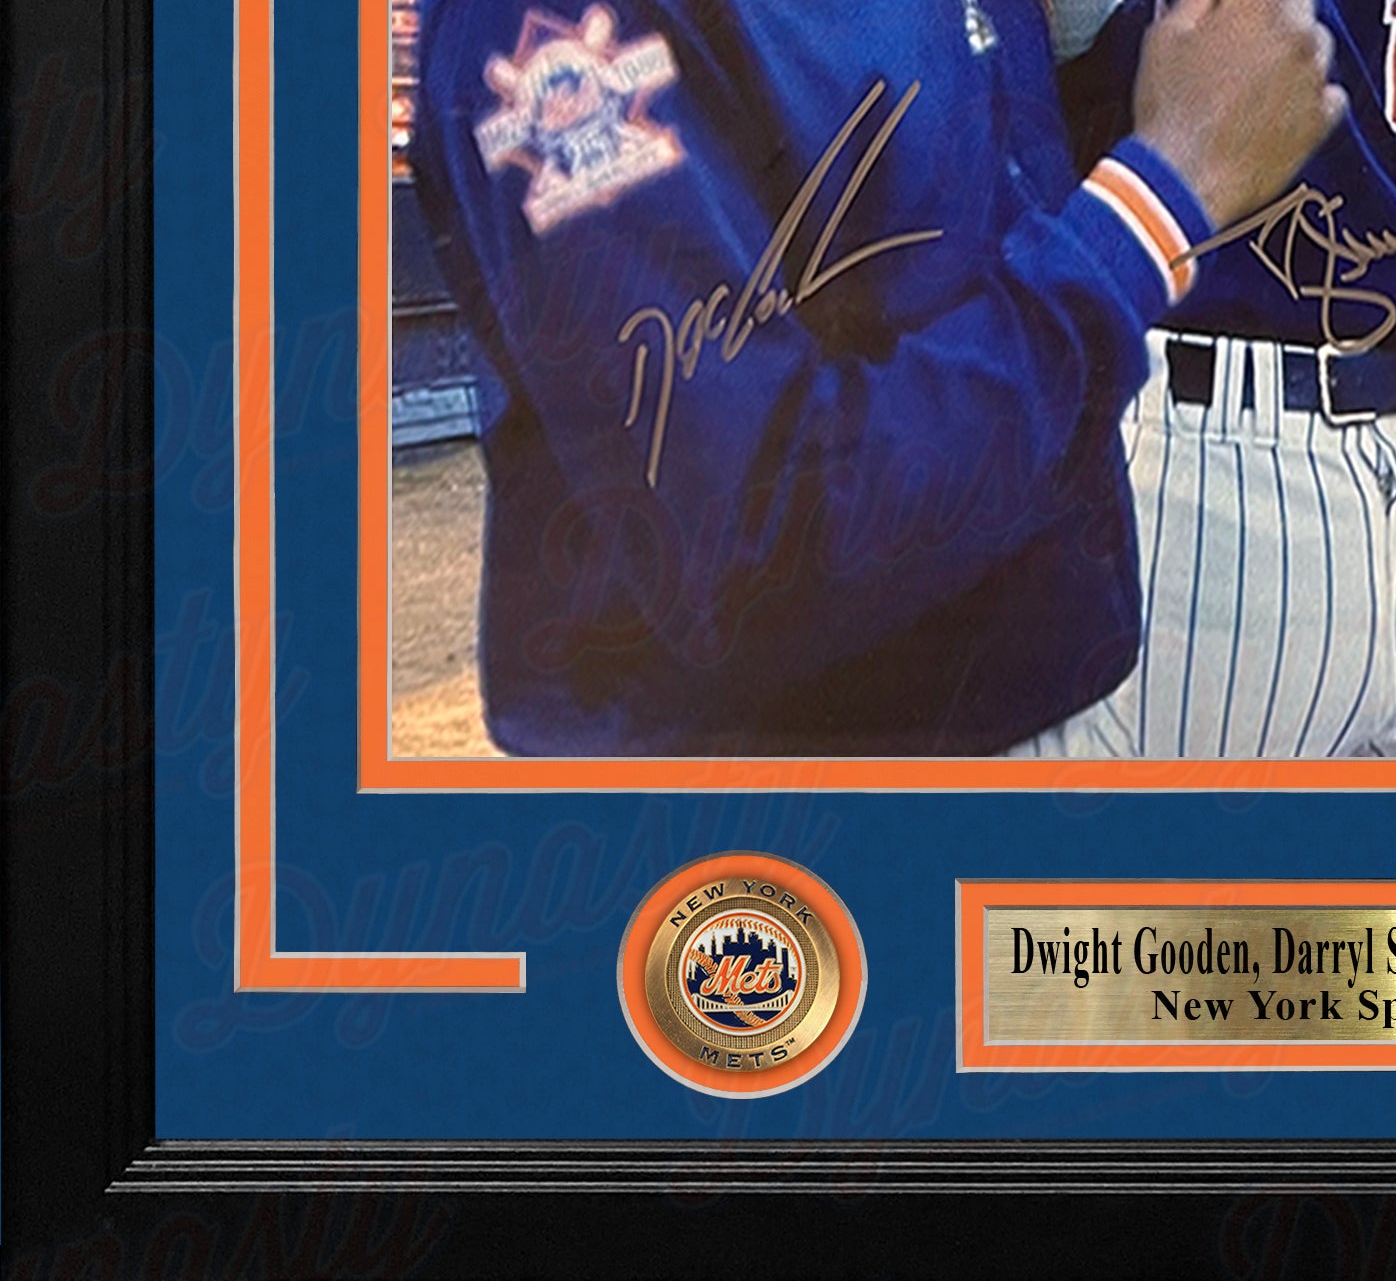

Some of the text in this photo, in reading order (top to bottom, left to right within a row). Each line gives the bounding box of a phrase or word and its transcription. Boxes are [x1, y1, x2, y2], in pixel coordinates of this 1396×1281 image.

[670, 880, 814, 928] NEW YORK
[700, 955, 783, 995] Mets
[1011, 926, 1122, 988] Dwight
[1133, 926, 1260, 984] Gooden,
[1272, 926, 1375, 988] Darryl
[1151, 989, 1239, 1021] New
[1247, 989, 1340, 1021] York
